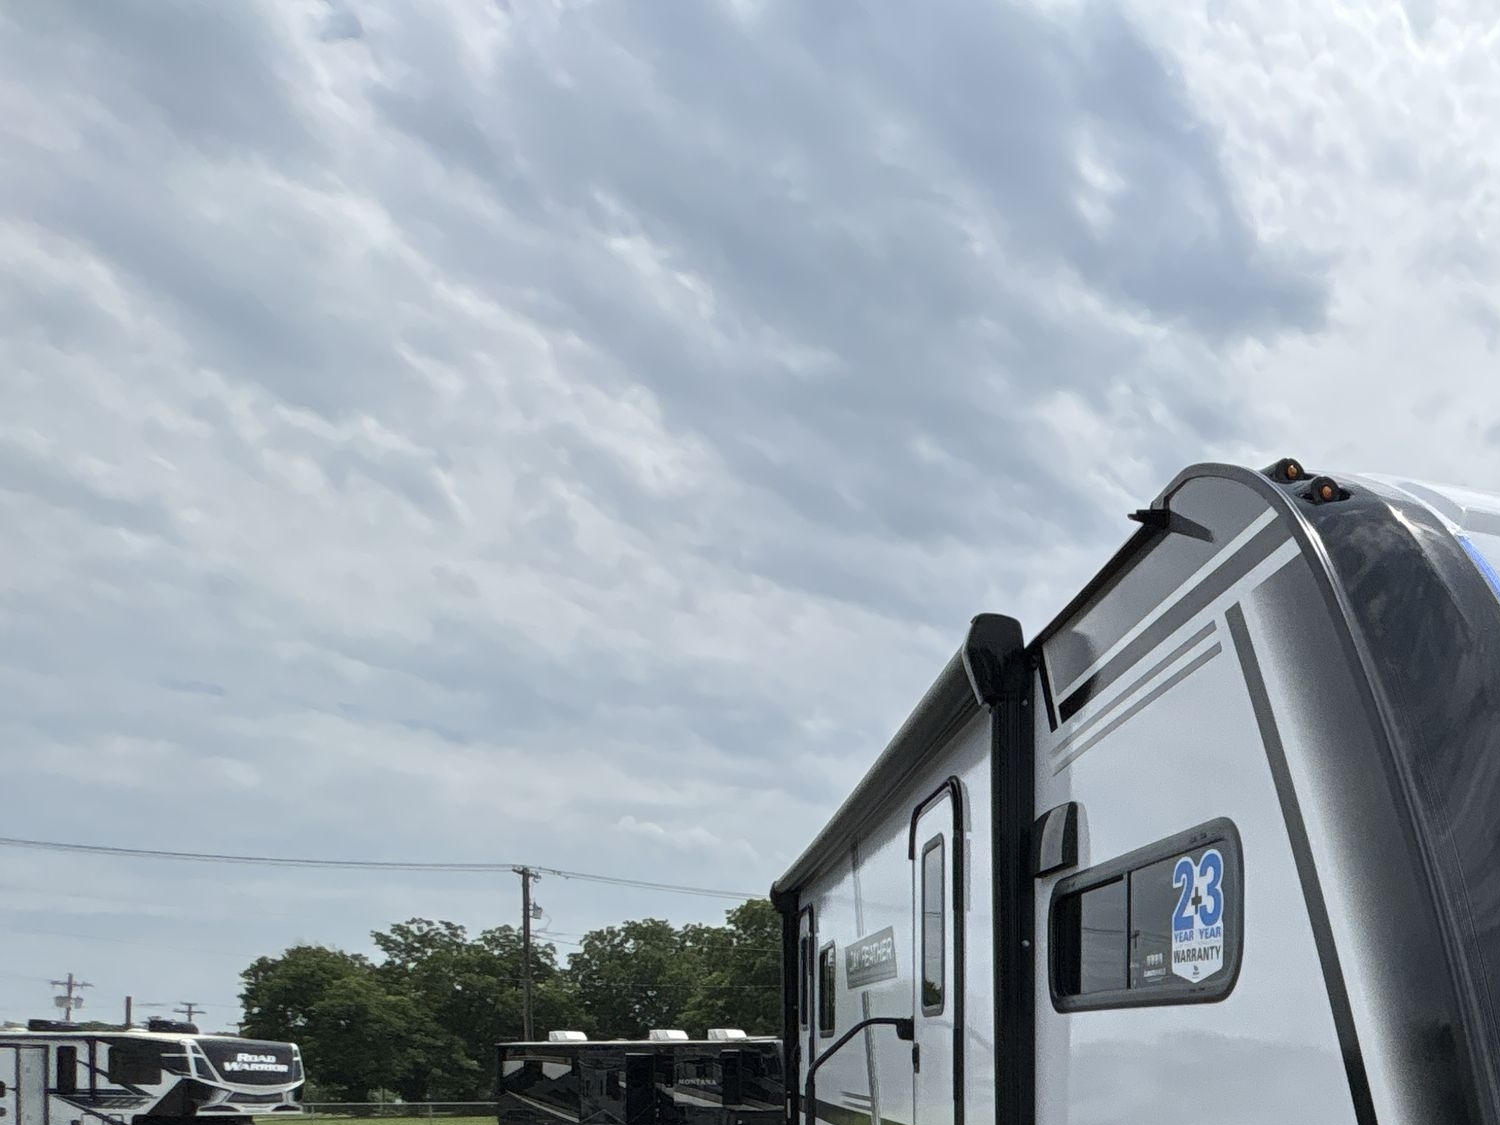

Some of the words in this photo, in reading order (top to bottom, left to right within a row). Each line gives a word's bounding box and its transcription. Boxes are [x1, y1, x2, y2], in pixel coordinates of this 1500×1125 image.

[1174, 930, 1194, 943] YEAR
[1199, 926, 1222, 940] YEAR
[1173, 945, 1222, 964] WARRANTY
